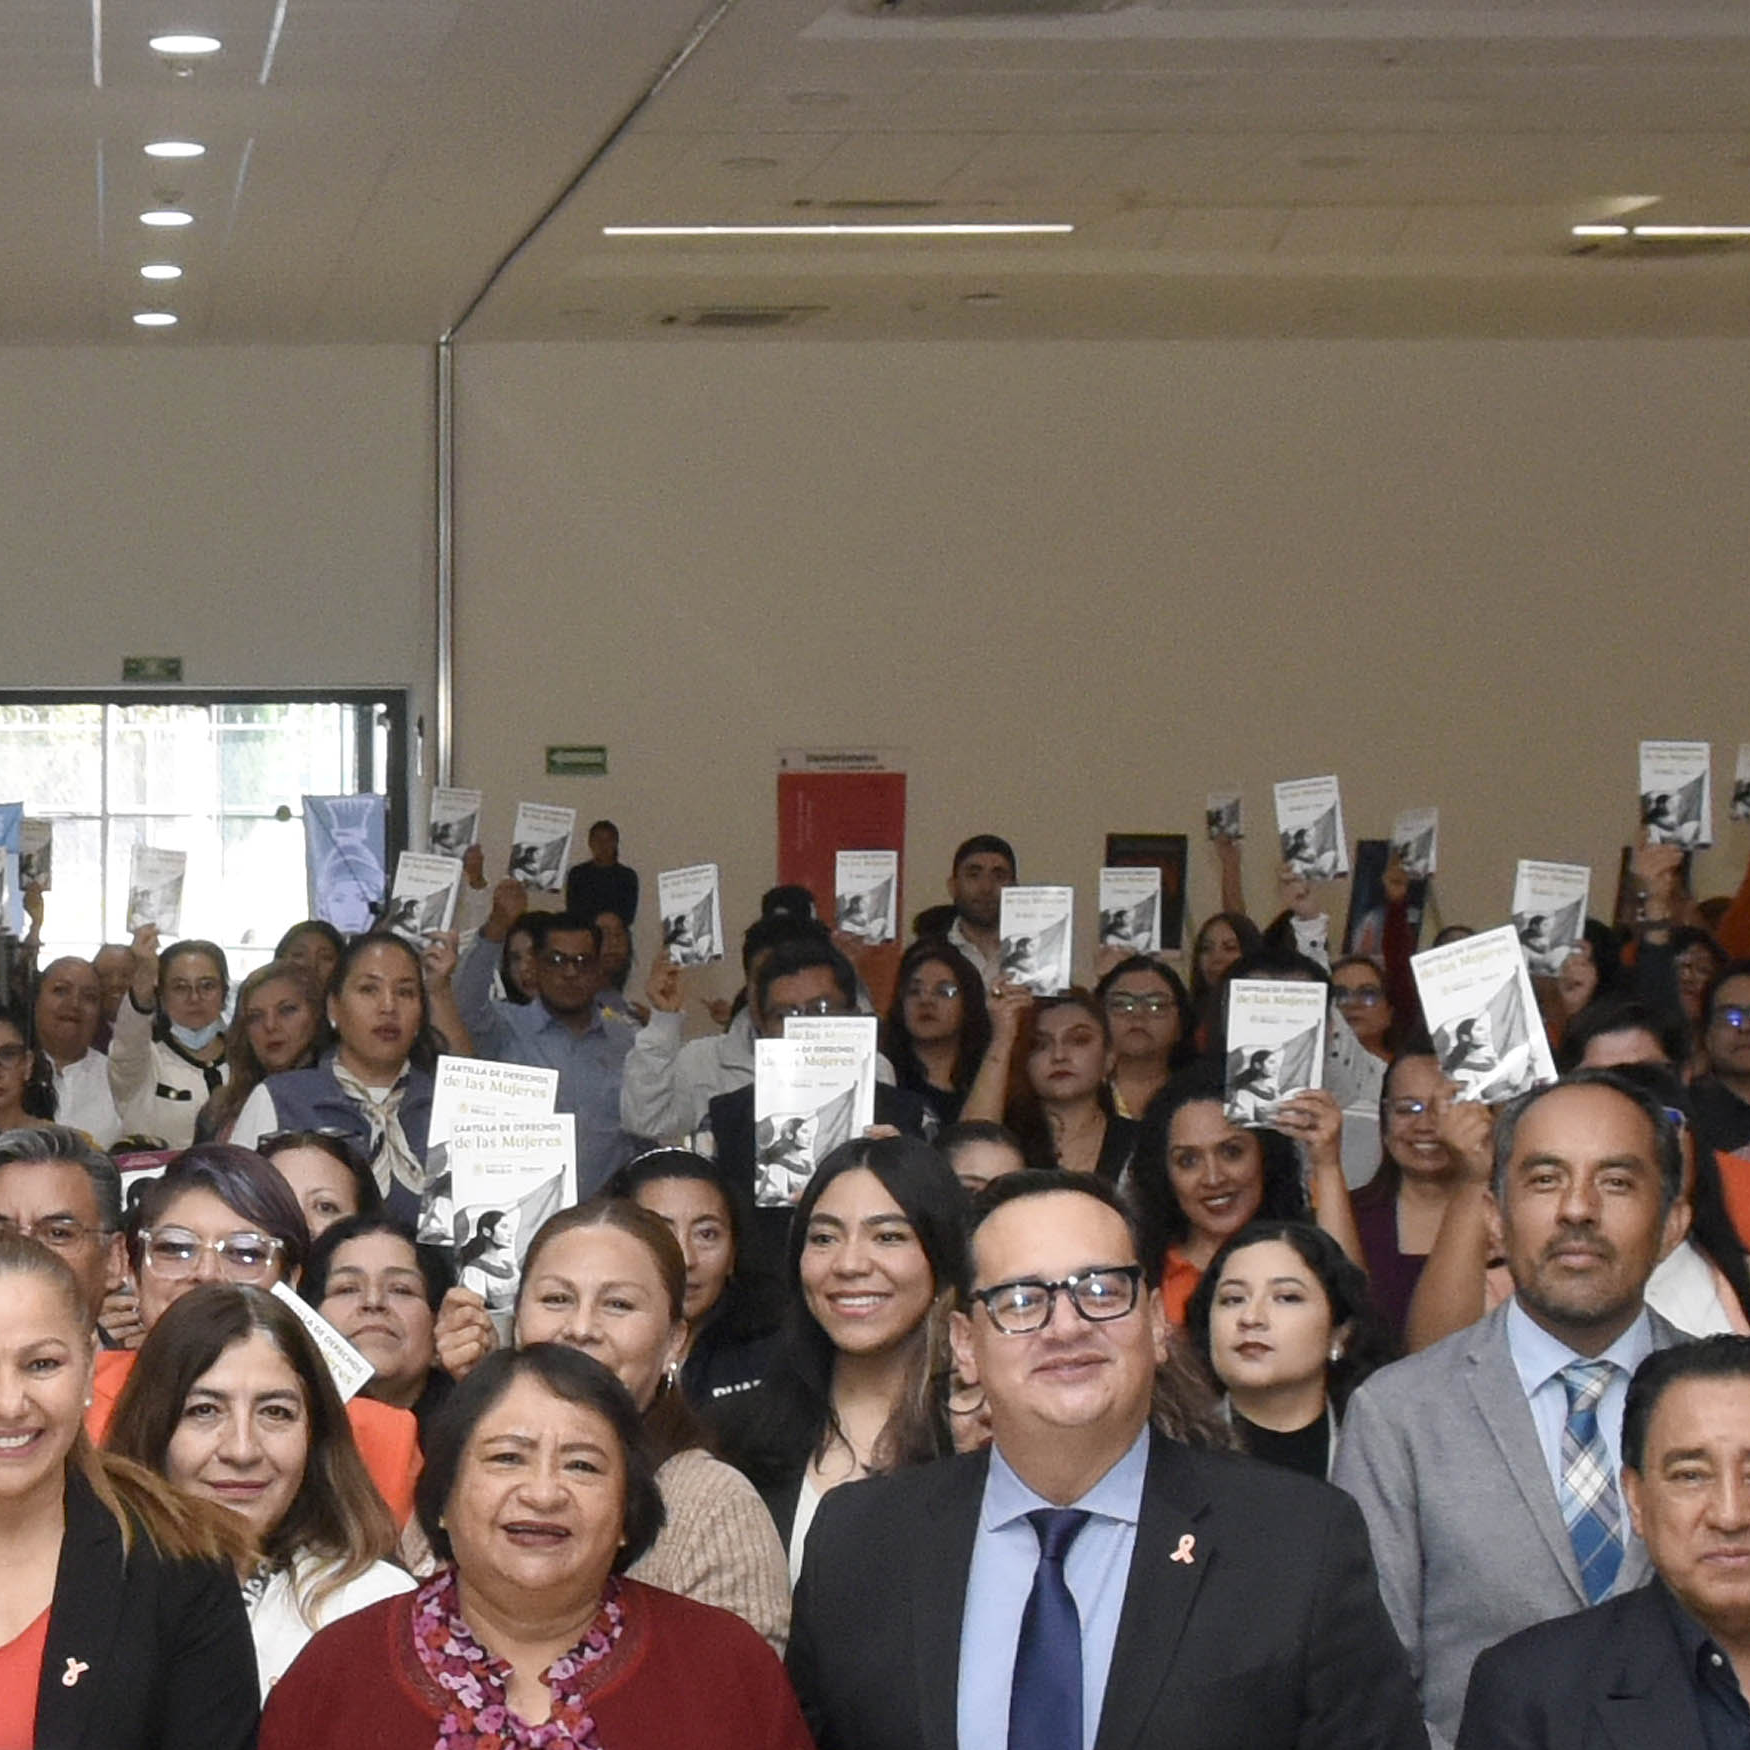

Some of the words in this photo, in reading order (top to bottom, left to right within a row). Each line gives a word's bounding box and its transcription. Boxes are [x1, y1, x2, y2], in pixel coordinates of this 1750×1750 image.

[444, 1064, 487, 1077] CARTILLA
[489, 1069, 500, 1078] DE
[502, 1071, 549, 1085] DERECHOS
[443, 1074, 461, 1088] de
[465, 1076, 485, 1091] las
[489, 1080, 548, 1098] Mujeres
[453, 1124, 496, 1134] CARTILLA
[499, 1124, 510, 1133] DE
[513, 1123, 561, 1133] DERECHOS
[454, 1135, 472, 1149] de
[476, 1135, 496, 1148] las
[501, 1135, 562, 1150] Mujeres
